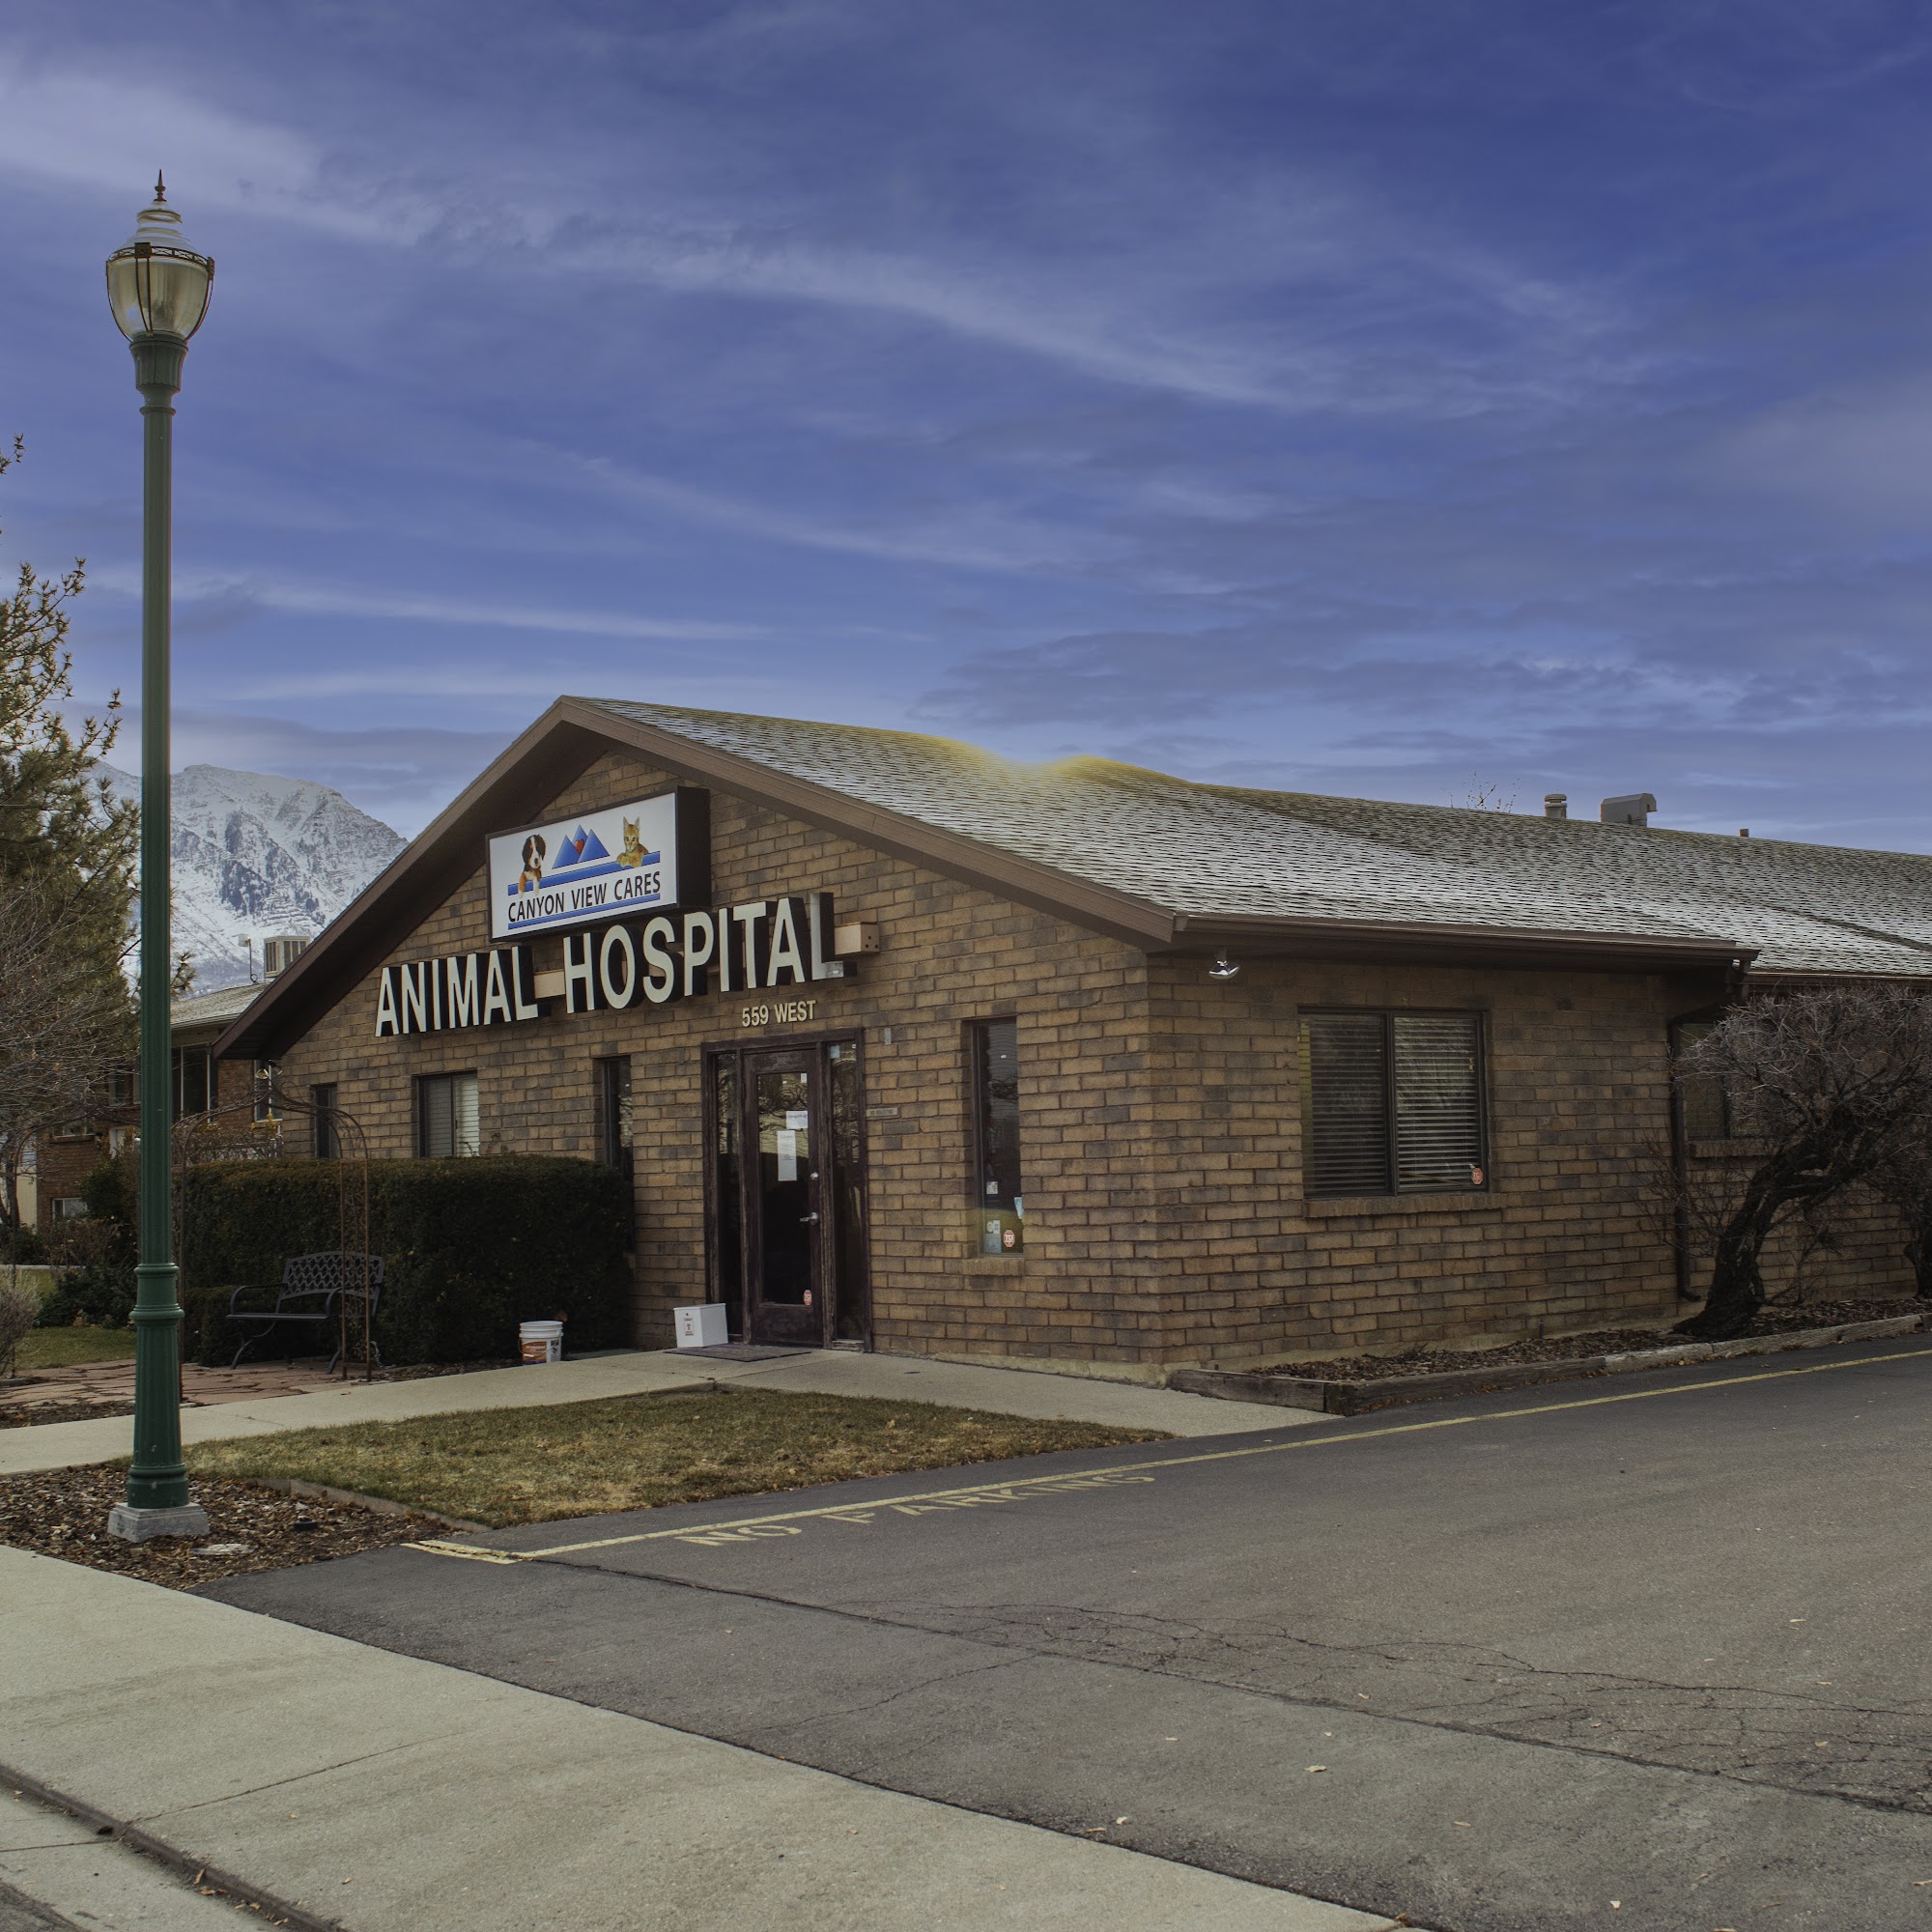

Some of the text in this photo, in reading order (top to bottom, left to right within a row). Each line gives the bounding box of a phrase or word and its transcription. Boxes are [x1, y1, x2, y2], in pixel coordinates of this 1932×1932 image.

[508, 871, 661, 923] CANYON VIEW CARES
[375, 893, 844, 1037] ANIMAL HOSPITAL
[742, 1000, 816, 1027] 559 WEST
[674, 1524, 803, 1547] NO
